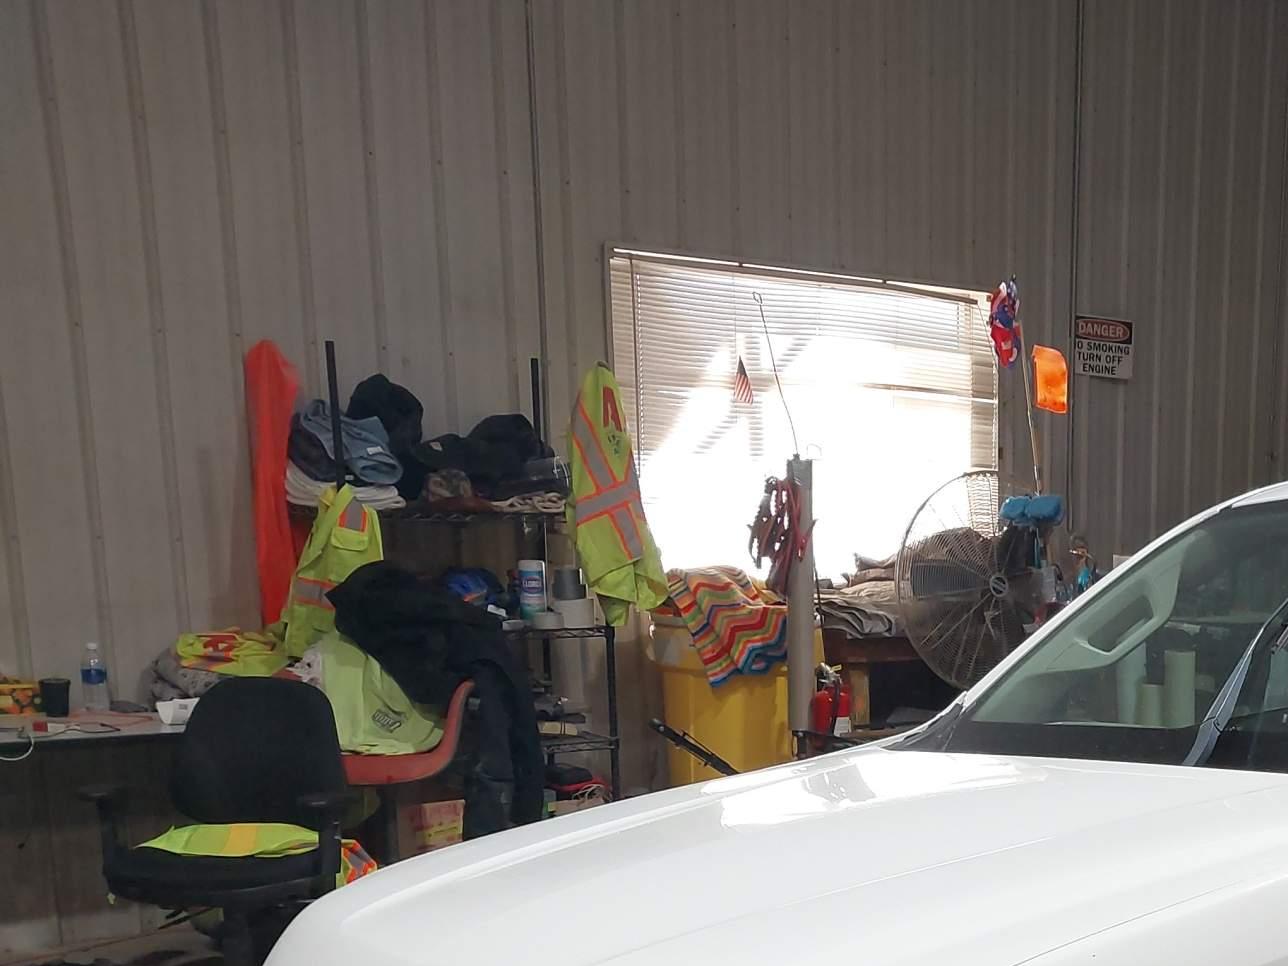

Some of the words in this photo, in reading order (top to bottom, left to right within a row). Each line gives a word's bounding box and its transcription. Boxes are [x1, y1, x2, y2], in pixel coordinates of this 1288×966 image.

[1079, 321, 1124, 338] DANGER
[1087, 341, 1130, 356] SMOKING
[1077, 350, 1102, 363] TURN
[1105, 354, 1123, 367] OFF
[1082, 362, 1117, 376] ENGINE
